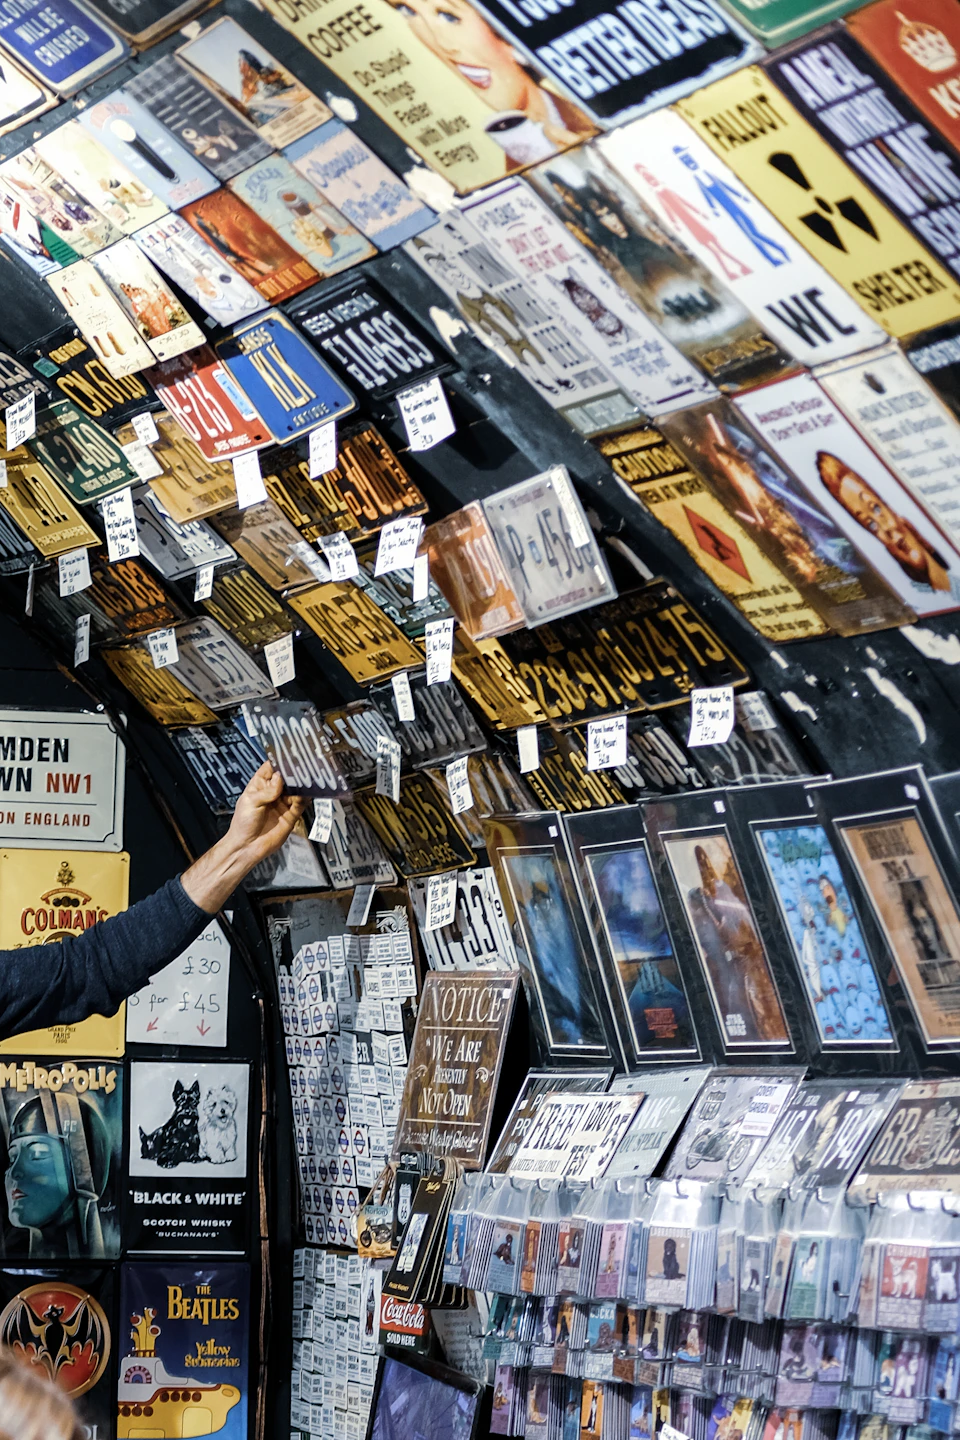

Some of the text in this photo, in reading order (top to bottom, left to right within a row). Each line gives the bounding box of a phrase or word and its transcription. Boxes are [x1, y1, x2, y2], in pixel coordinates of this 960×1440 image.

[14, 18, 44, 45] WILL
[307, 4, 384, 58] COFFEE
[34, 25, 90, 67] CRUSHED
[537, 14, 645, 99] BETTER
[371, 48, 412, 78] Stupid
[372, 80, 415, 107] Things
[394, 102, 433, 127] Faster
[701, 95, 789, 150] FALLOUT
[433, 141, 480, 168] Energy
[852, 260, 948, 313] SHELTER
[766, 287, 858, 348] WC
[611, 444, 686, 481] CAUTION
[46, 772, 92, 794] NW1
[24, 812, 91, 827] ENGLAND
[21, 906, 109, 936] COLMAN'S
[182, 956, 221, 976] £30
[149, 992, 221, 1014] for £45
[426, 985, 503, 1023] NOTICE
[454, 1037, 481, 1063] ARE
[433, 1066, 468, 1085] PRESENTLY
[419, 1089, 473, 1116] NOT OPEN
[581, 1101, 621, 1132] IDIOT
[560, 1145, 598, 1176] TEST
[143, 1219, 233, 1227] SCOTCH WHISKY
[364, 1207, 389, 1217] Norton
[196, 1285, 211, 1295] THE
[167, 1285, 240, 1325] BEATLES
[381, 1297, 425, 1329] Coca-Cola
[196, 1338, 231, 1358] Yellow
[386, 1333, 416, 1347] SOLD HERE
